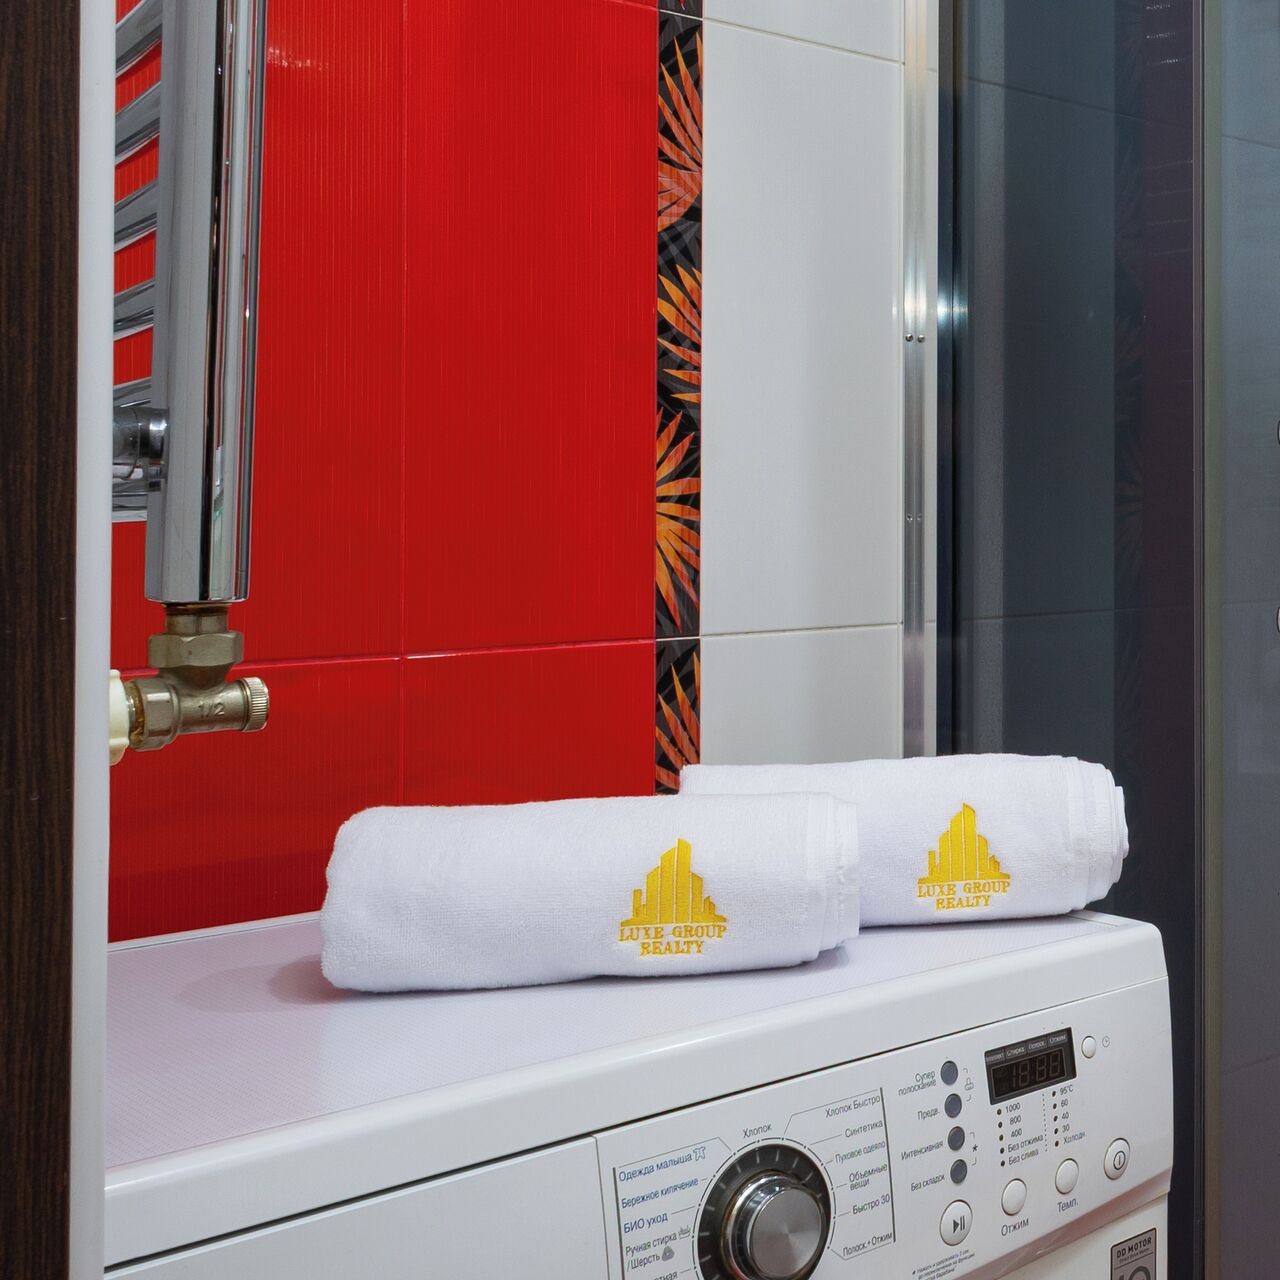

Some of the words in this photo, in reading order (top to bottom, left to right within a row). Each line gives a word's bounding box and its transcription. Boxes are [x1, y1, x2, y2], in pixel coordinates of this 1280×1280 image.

[917, 883, 956, 898] LUXE
[962, 880, 1010, 894] GROUP
[936, 894, 991, 910] REALTY
[618, 926, 664, 942] LUXE
[671, 924, 727, 939] GROUP
[640, 940, 704, 956] REALTY
[915, 1070, 936, 1084] Супер
[825, 1103, 853, 1118] Хлопок
[853, 1095, 881, 1110] Быстро
[1005, 1102, 1021, 1113] 1000
[1061, 1098, 1069, 1107] 60
[1009, 1115, 1022, 1125] 800
[1061, 1111, 1070, 1120] 40
[742, 1123, 772, 1139] Хлопок
[844, 1119, 883, 1138] Синтетика
[1010, 1128, 1023, 1138] 400
[1062, 1124, 1070, 1133] 30
[835, 1146, 863, 1165] Пуховое
[863, 1140, 886, 1155] одеяло
[900, 1140, 943, 1161] Интенсивная
[1007, 1143, 1020, 1153] Без
[618, 1164, 655, 1182] Одежда
[656, 1152, 692, 1171] малыша
[1008, 1155, 1020, 1166] Без
[848, 1163, 888, 1183] Объемные
[849, 1178, 870, 1191] вещи
[910, 1181, 922, 1192] Без
[922, 1173, 945, 1188] складок
[621, 1190, 660, 1209] Бережное
[660, 1178, 699, 1197] кипячение
[852, 1198, 880, 1215] Быстро
[880, 1193, 890, 1205] 30
[1057, 1198, 1079, 1213] Темп.
[623, 1218, 645, 1234] БИО
[646, 1212, 669, 1229] уход
[1001, 1217, 1029, 1237] Отжим
[625, 1241, 652, 1257] Ручная
[652, 1232, 678, 1248] стирка
[1116, 1248, 1126, 1259] DD
[1128, 1236, 1152, 1253] MOTOR
